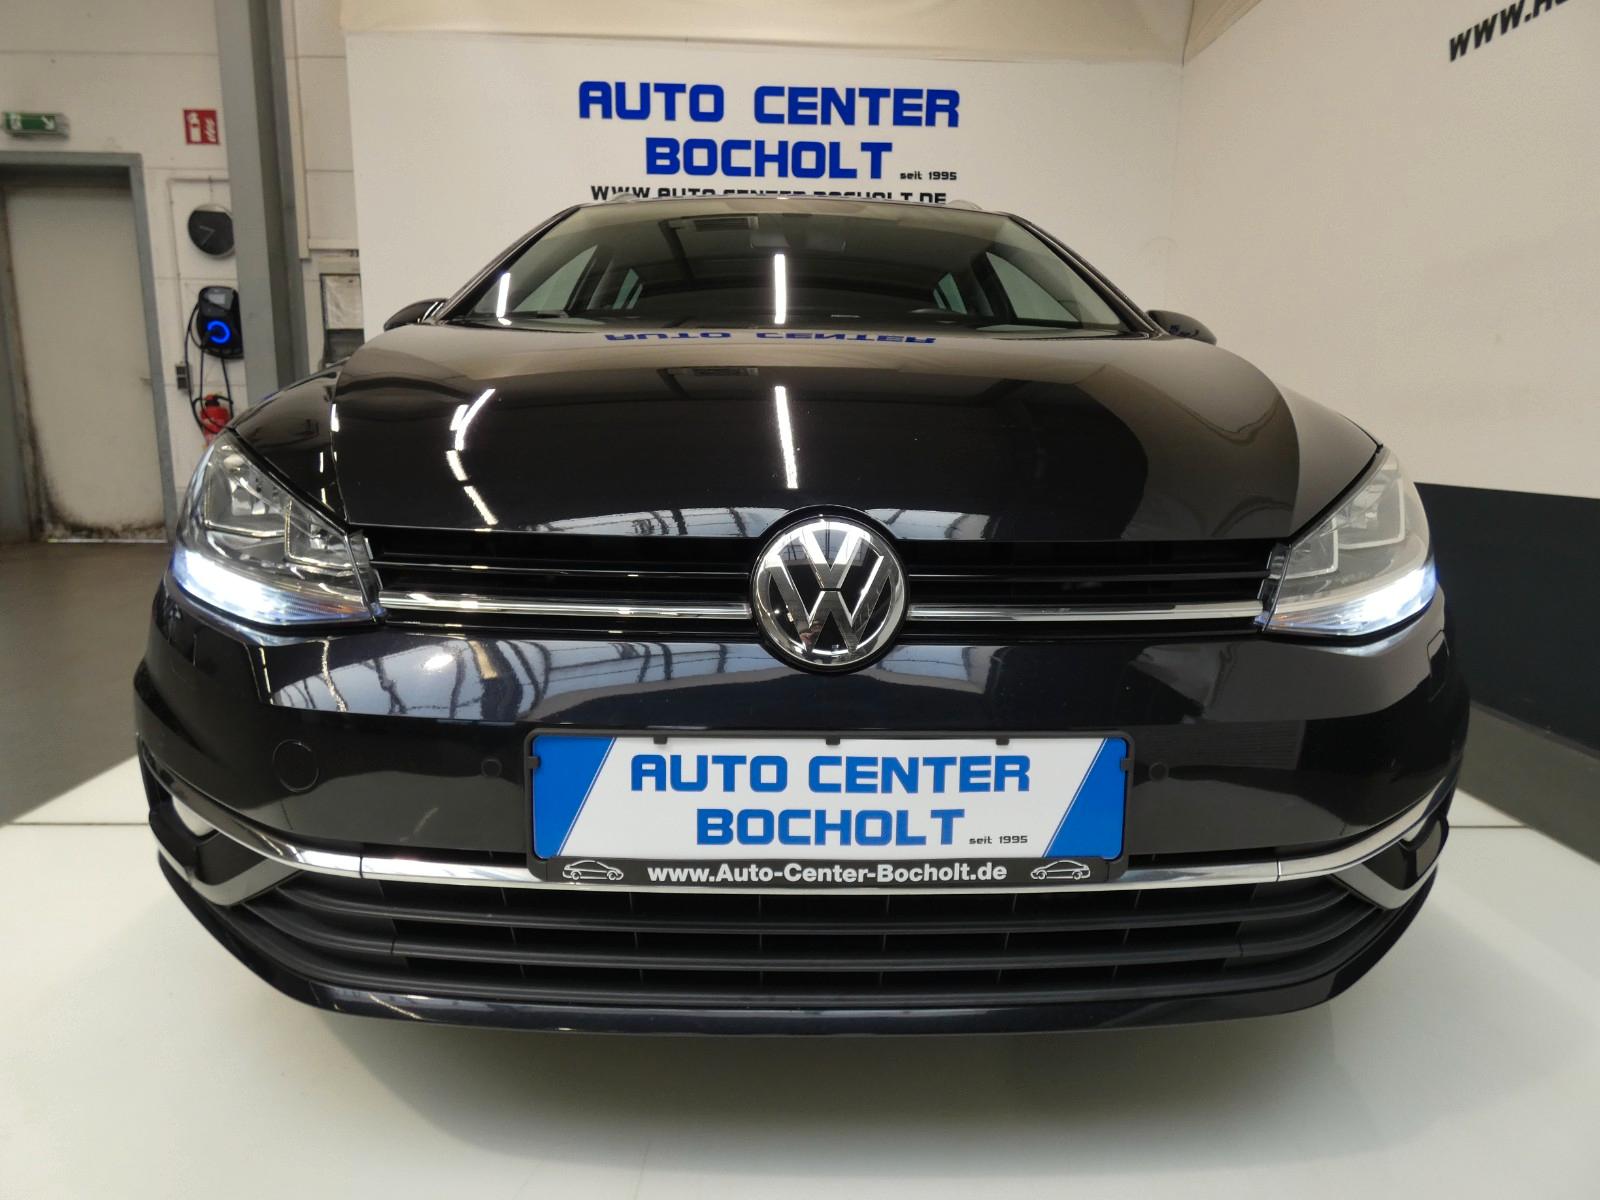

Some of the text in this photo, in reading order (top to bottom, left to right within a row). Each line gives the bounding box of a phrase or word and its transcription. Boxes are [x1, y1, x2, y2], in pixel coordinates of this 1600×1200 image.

[578, 80, 961, 128] AUTO CENTER
[645, 136, 957, 181] BOCHOLT seit 1995
[760, 519, 898, 659] VW
[630, 752, 1031, 795] AUTO CENTER
[696, 807, 1029, 847] BOCHOLT seit 1995
[646, 862, 1008, 884] www.Auto-Center-Bocholt.de
